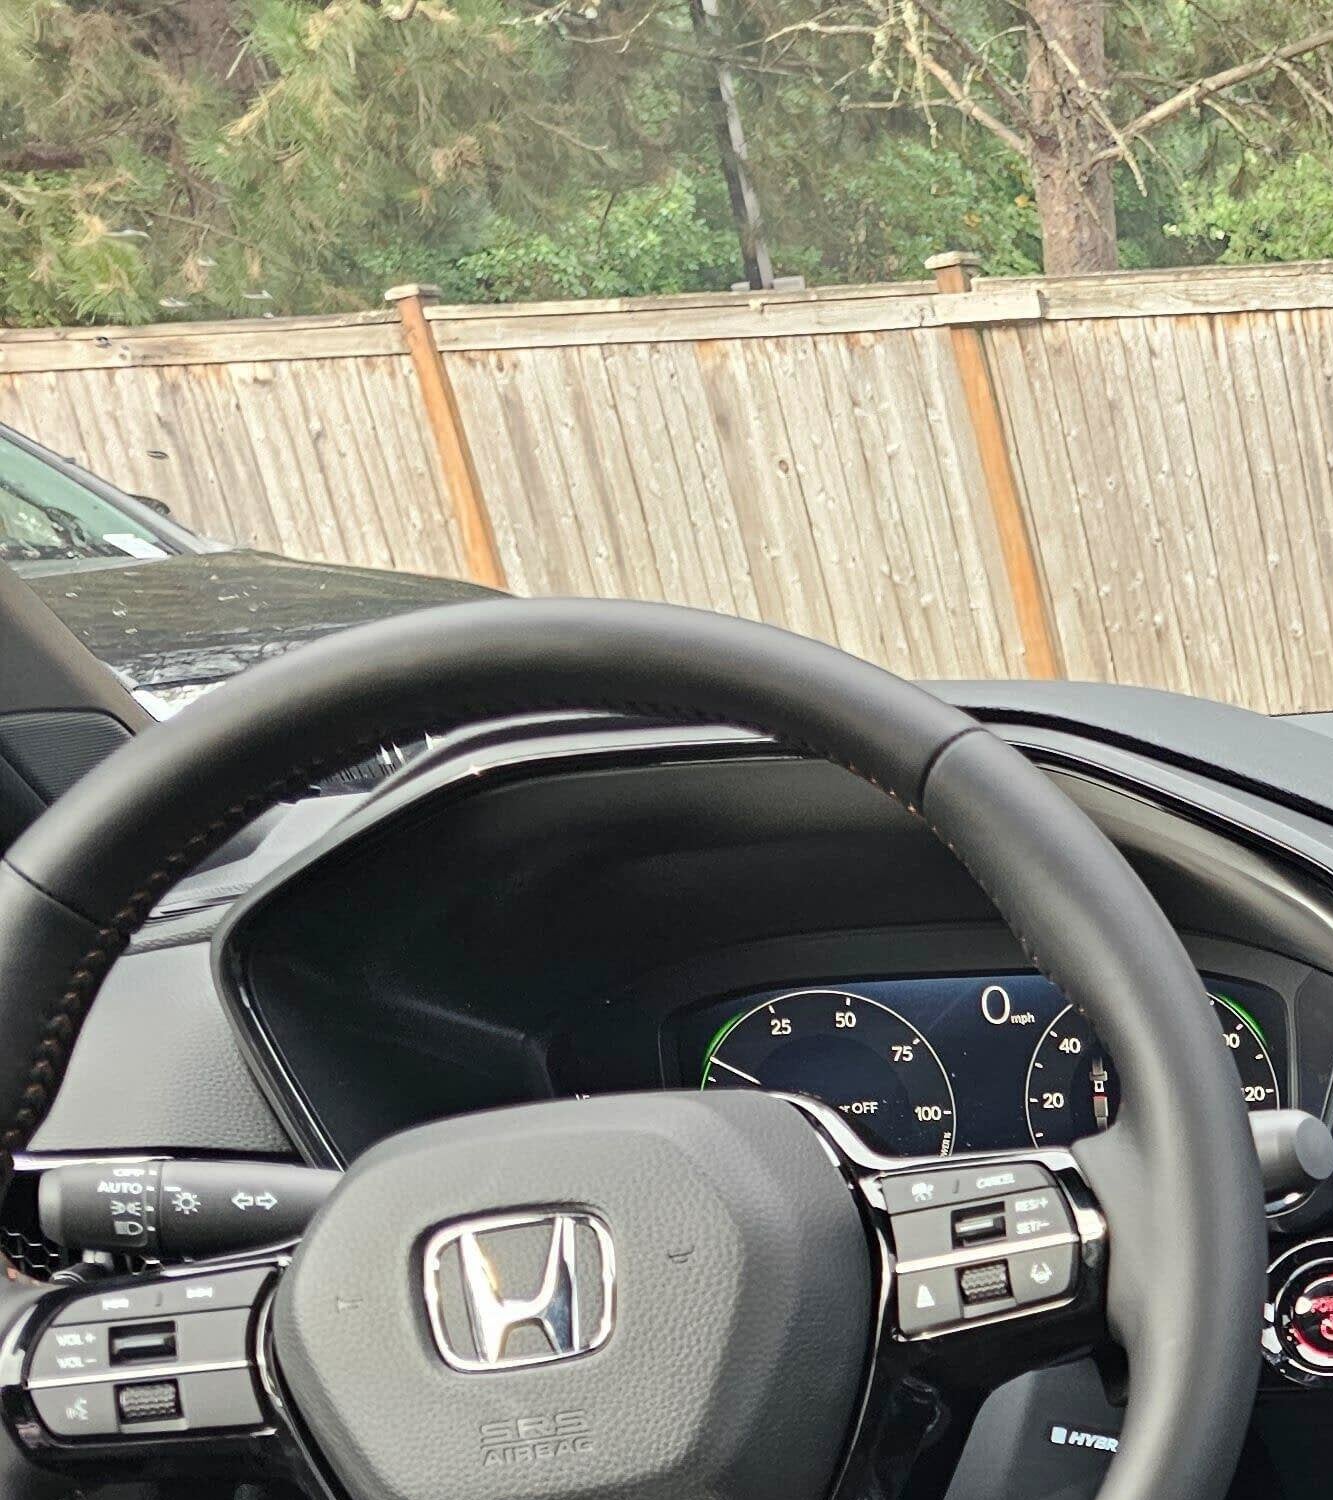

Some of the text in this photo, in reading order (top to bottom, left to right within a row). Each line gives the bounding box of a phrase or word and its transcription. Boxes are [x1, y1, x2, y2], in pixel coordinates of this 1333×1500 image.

[981, 985, 1035, 1026] 0 mph
[770, 1019, 792, 1036] 25
[835, 1012, 856, 1028] 50
[891, 1045, 914, 1062] 75
[1058, 1037, 1081, 1054] 40
[851, 1101, 879, 1115] OFF
[1042, 1092, 1065, 1109] 20
[914, 1105, 942, 1122] 100
[97, 1180, 143, 1195] AUTO
[480, 1407, 588, 1445] SRS
[482, 1437, 594, 1467] AIRBAG
